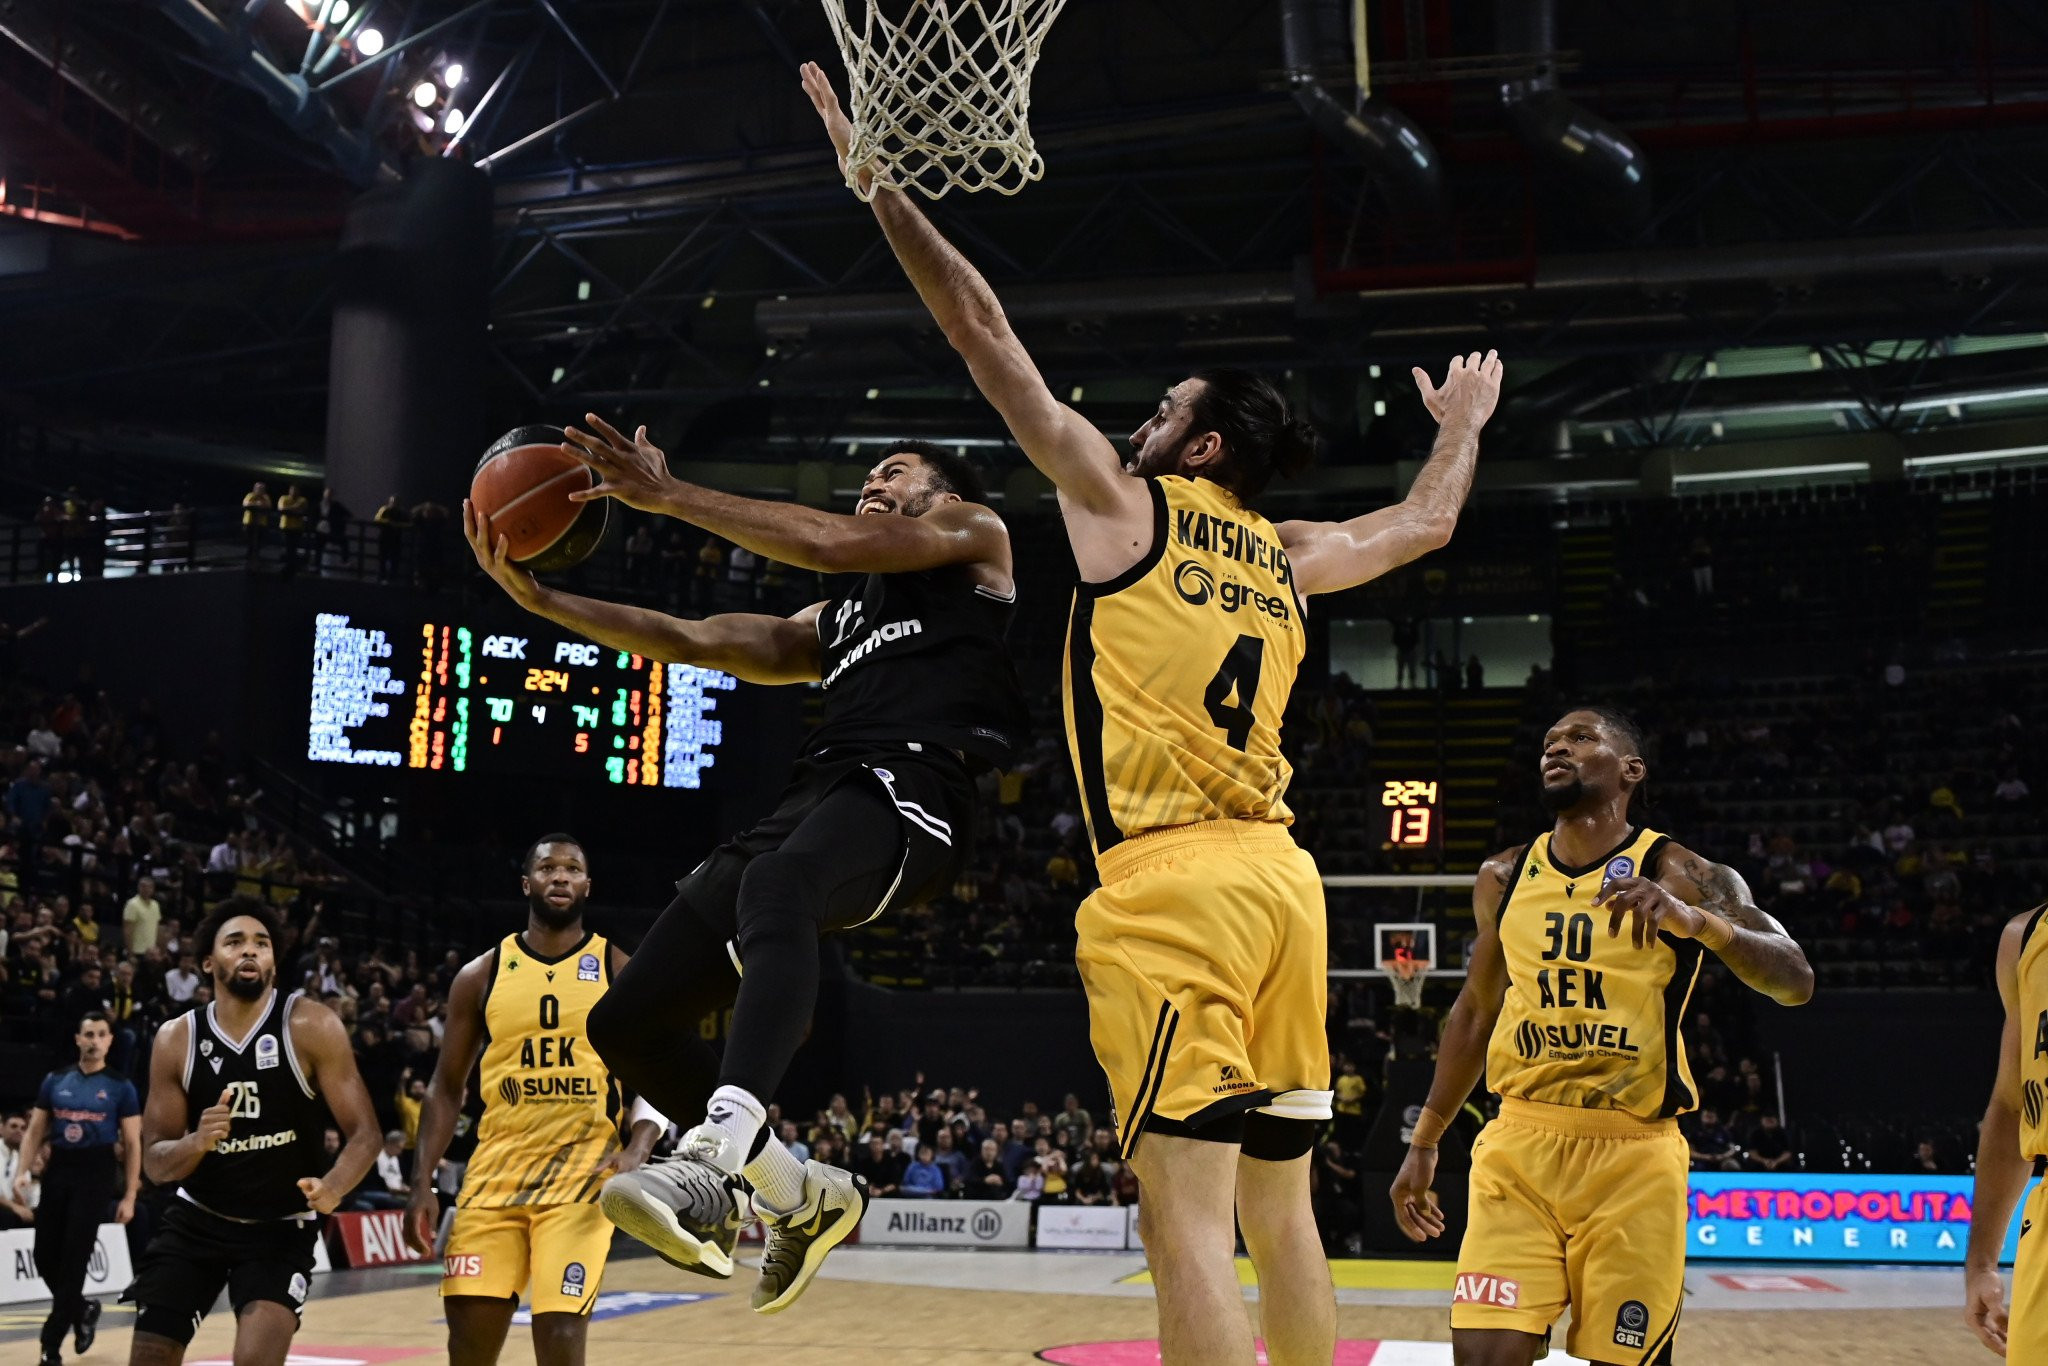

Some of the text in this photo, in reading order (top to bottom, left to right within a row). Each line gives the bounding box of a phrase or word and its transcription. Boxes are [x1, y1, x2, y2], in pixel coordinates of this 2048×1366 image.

[481, 634, 529, 660] AEK
[554, 641, 600, 667] PBC
[1203, 633, 1264, 754] 4
[485, 697, 514, 722] 70
[531, 705, 547, 724] 4
[571, 704, 600, 728] 74
[492, 726, 590, 753] 1 5
[1381, 780, 1437, 806] 2:24
[1391, 807, 1430, 844] 13
[1541, 912, 1594, 963] 30
[1537, 968, 1608, 1011] AEK
[539, 994, 559, 1030] 0
[520, 1037, 576, 1069] AEK
[1546, 1023, 1639, 1052] SUNEL
[226, 1081, 260, 1119] 26
[523, 1077, 597, 1096] SUNEL
[1212, 1082, 1255, 1094] VARAGONS
[216, 1129, 297, 1155] oiximan
[887, 1211, 966, 1234] Allianz
[1453, 1275, 1517, 1307] AVIS
[1615, 1332, 1642, 1347] GBL
